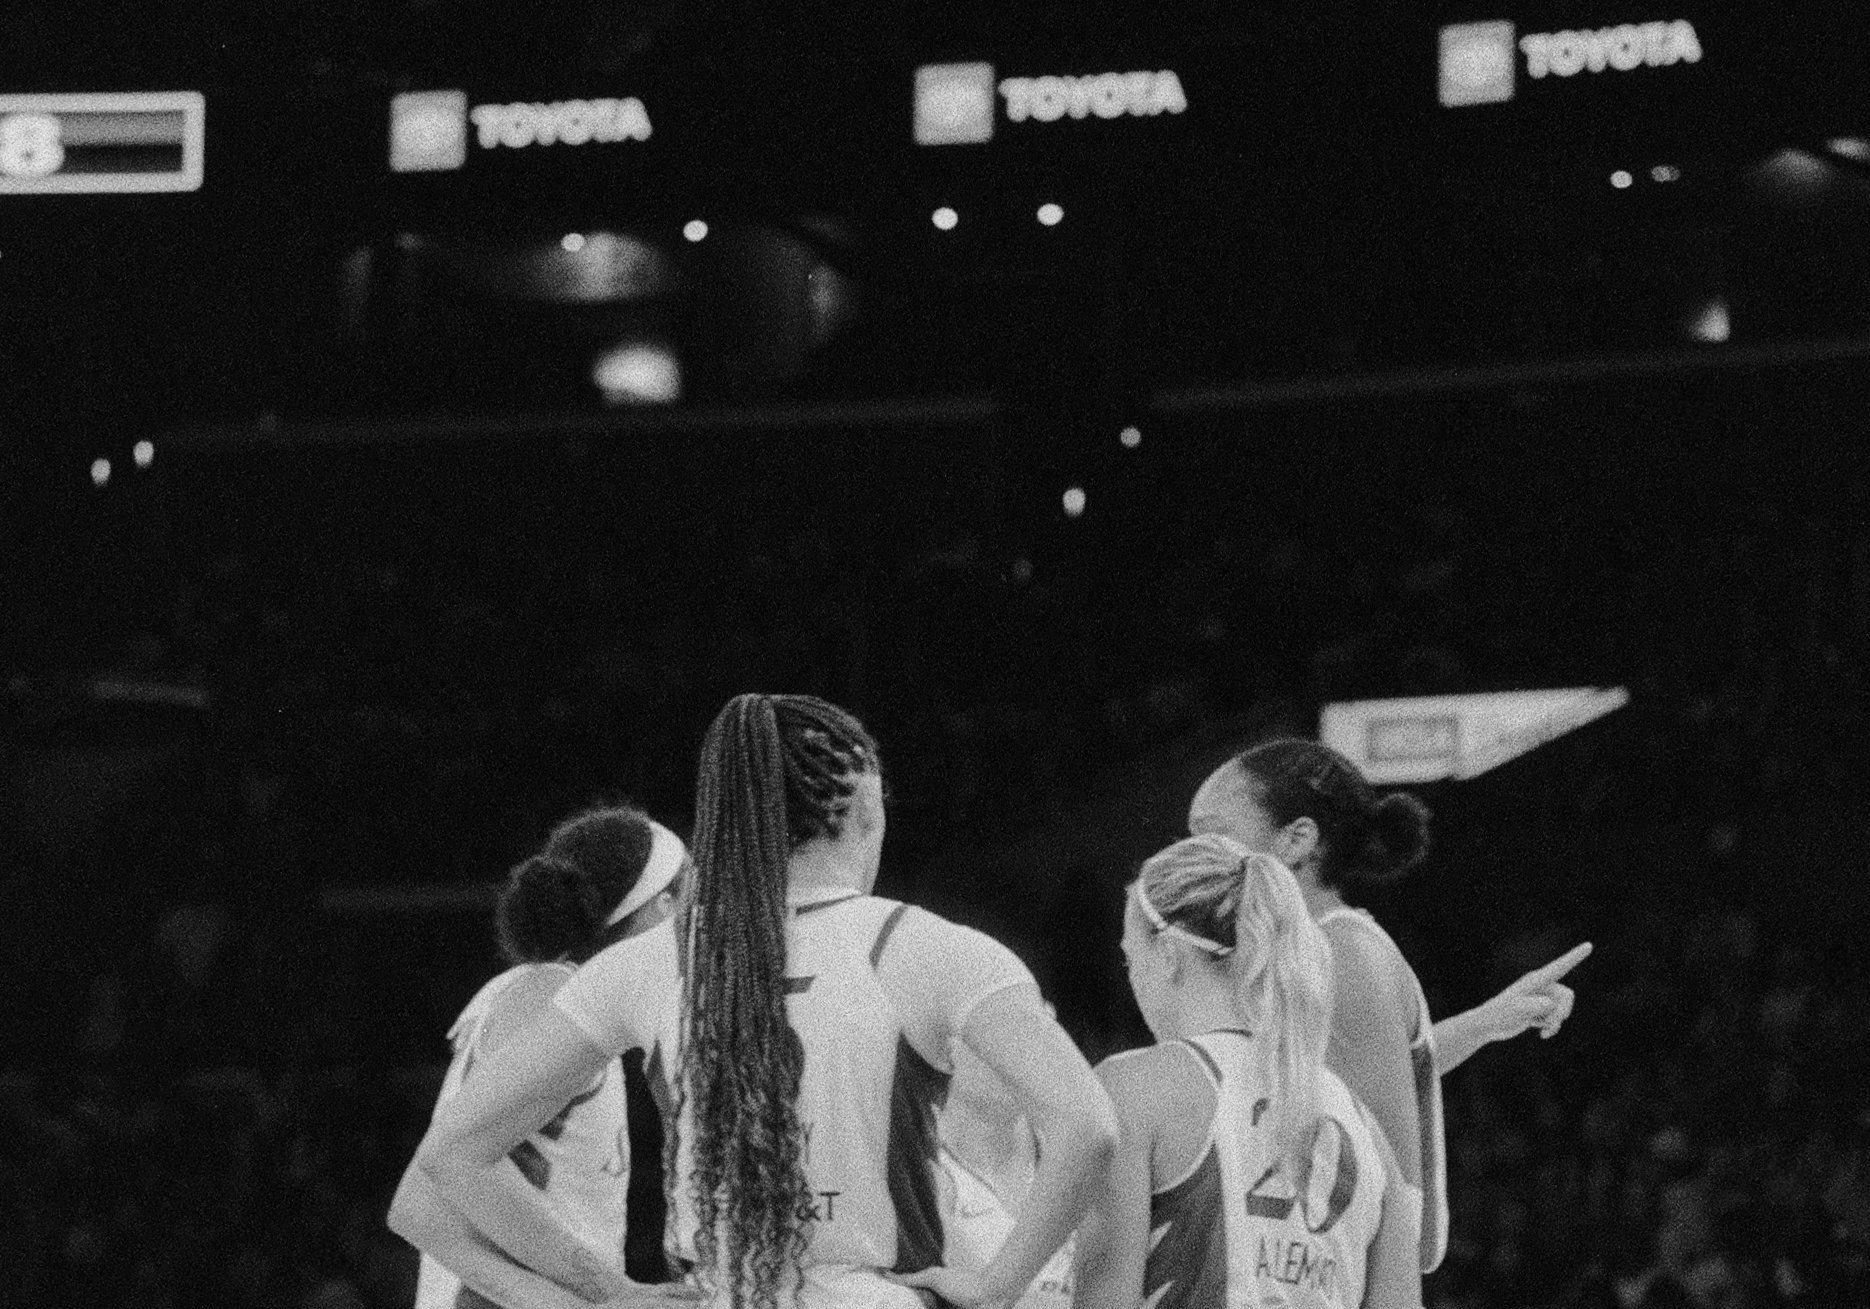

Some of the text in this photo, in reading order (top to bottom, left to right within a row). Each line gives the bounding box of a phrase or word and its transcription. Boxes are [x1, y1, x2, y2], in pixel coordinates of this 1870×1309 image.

[1519, 19, 1703, 79] TOYOTA
[998, 70, 1188, 122] TOYOTA
[470, 97, 652, 149] TOYOTA
